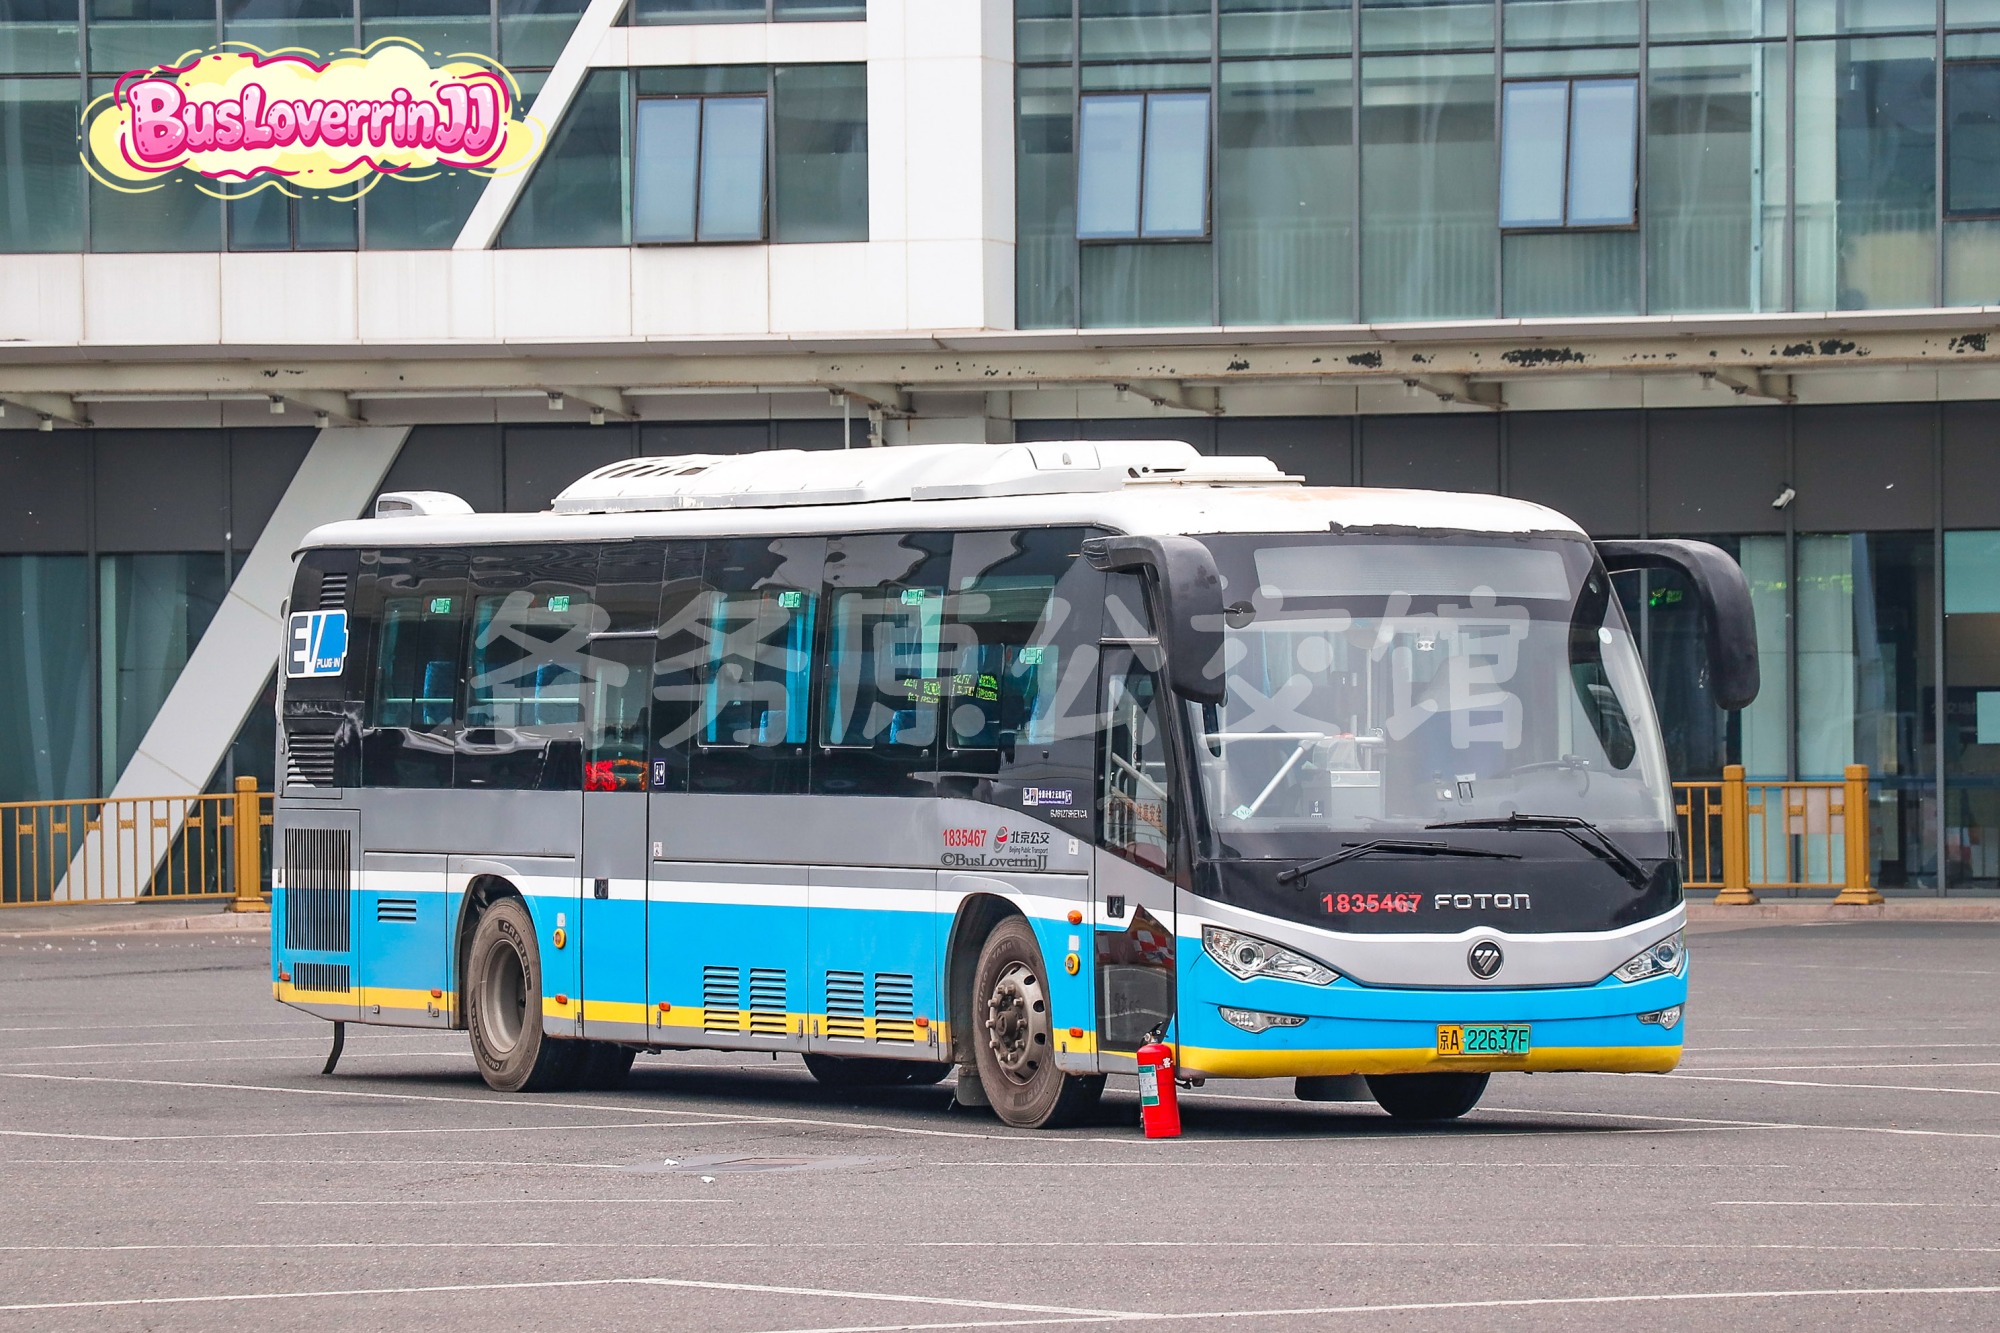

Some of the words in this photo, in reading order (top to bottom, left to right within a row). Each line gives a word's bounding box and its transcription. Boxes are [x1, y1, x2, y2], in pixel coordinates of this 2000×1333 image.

[316, 658, 341, 669] PLUG-IN
[943, 829, 987, 847] 1835467
[1010, 831, 1051, 845] 北京公交
[1009, 846, 1021, 854] Beijing
[1031, 846, 1049, 854] Transport
[1322, 893, 1422, 913] 1835467
[1434, 893, 1531, 910] FOTON
[1467, 1029, 1529, 1051] 22637F
